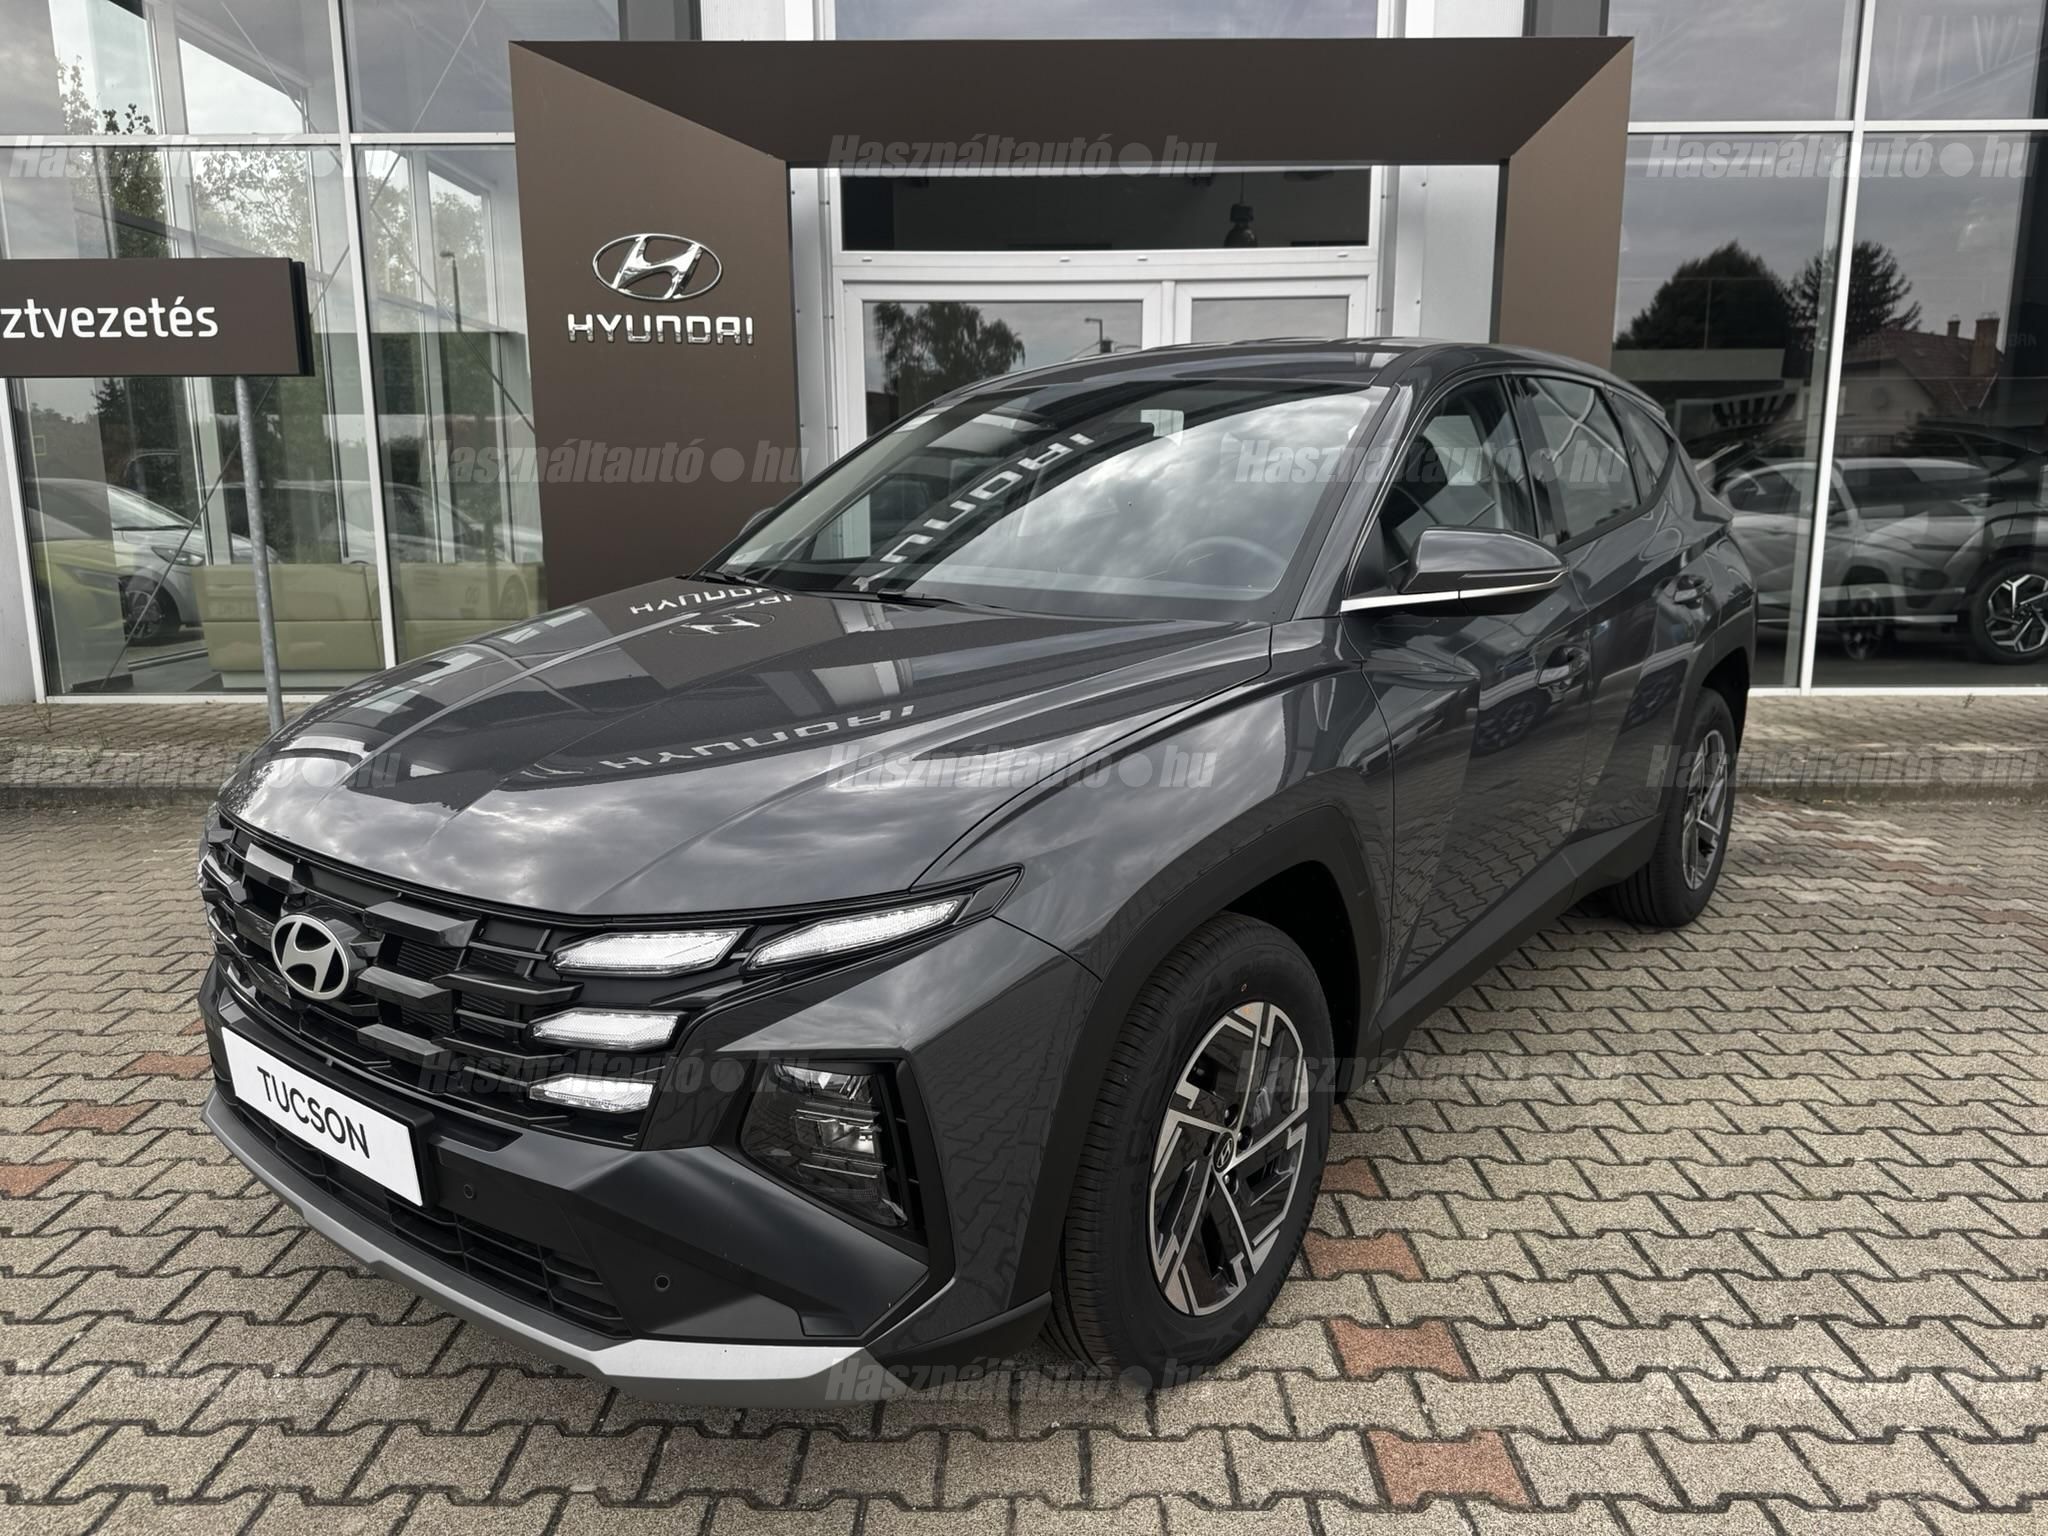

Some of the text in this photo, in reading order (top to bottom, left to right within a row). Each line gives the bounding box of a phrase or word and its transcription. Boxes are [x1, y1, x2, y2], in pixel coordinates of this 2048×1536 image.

[0, 296, 218, 338] ztvezetés
[567, 313, 754, 345] HYUNDAI
[256, 1065, 370, 1159] TUCSON
